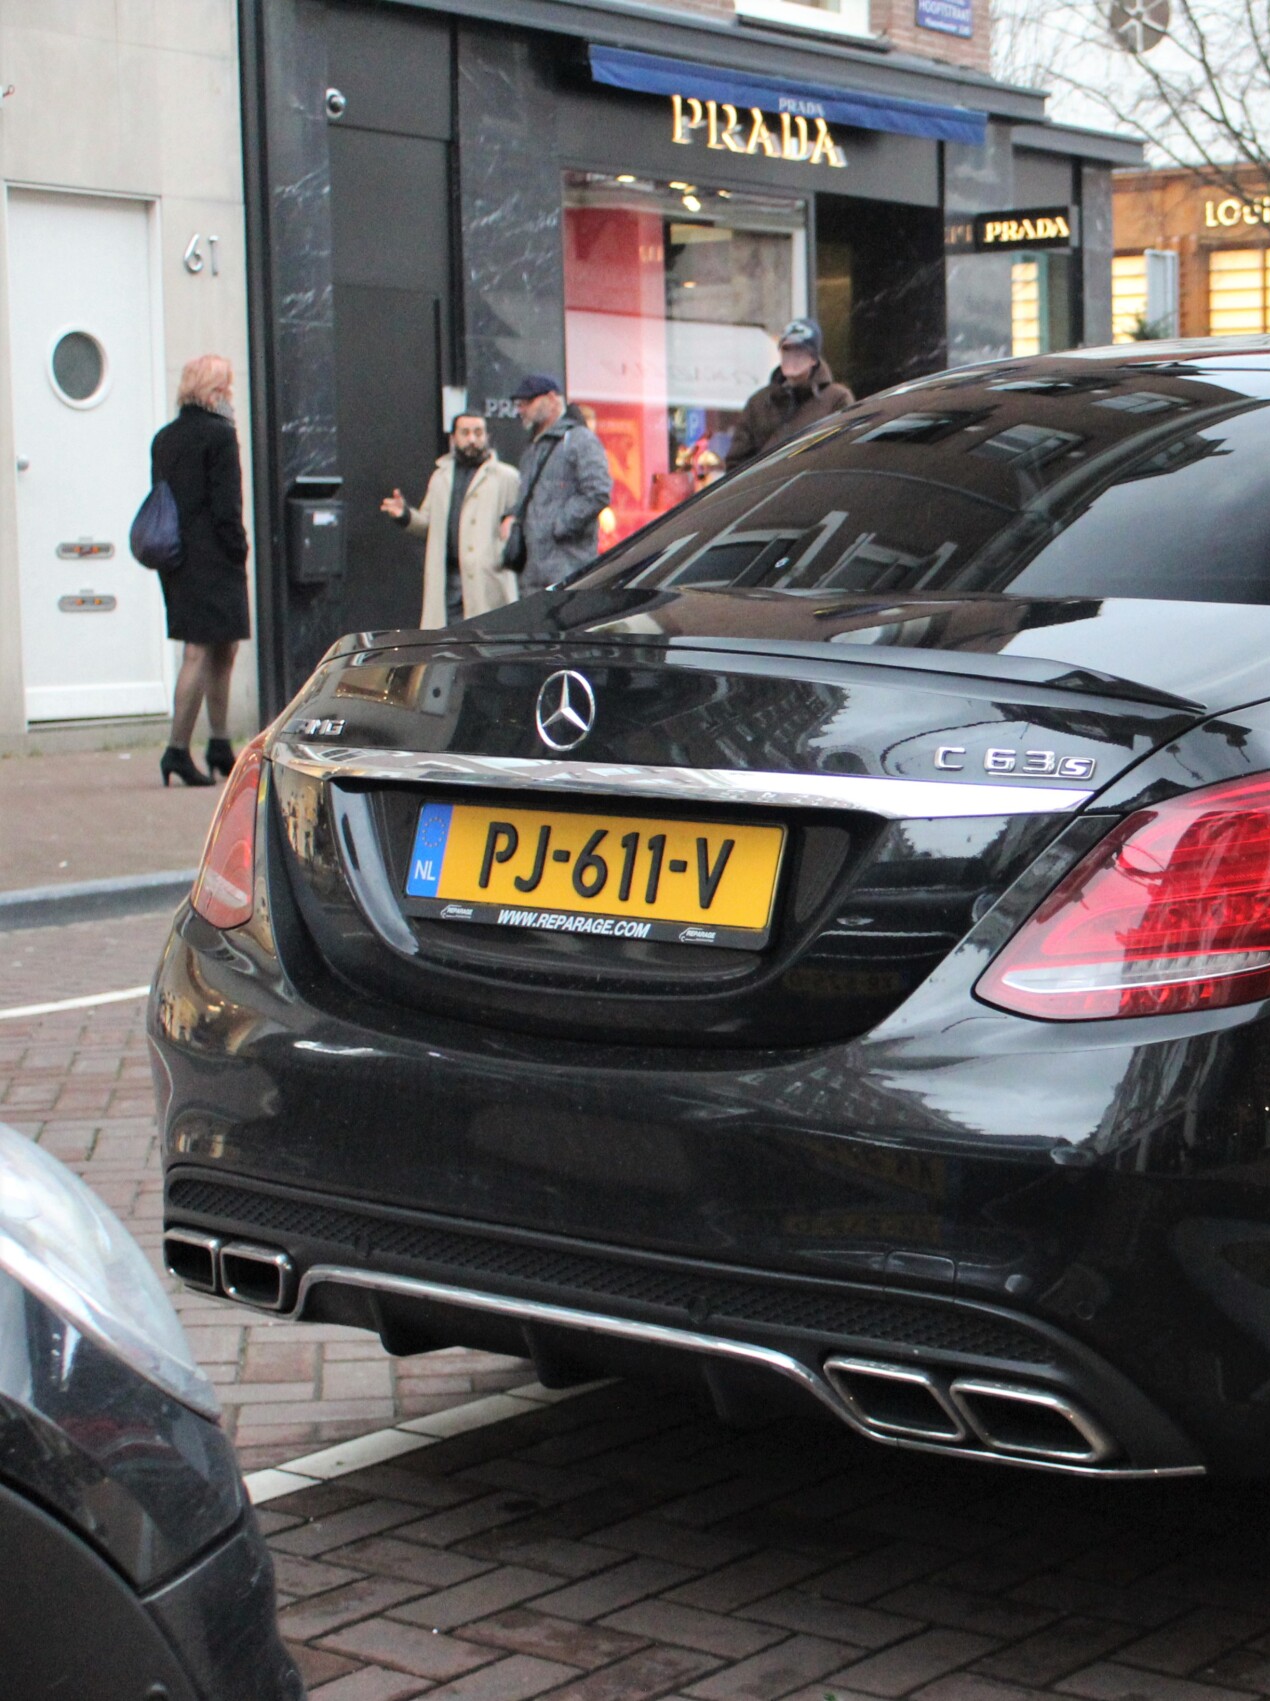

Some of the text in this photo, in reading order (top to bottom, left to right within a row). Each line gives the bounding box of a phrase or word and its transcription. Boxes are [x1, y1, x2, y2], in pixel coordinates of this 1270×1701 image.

[778, 97, 826, 118] PRADA
[672, 94, 848, 168] PRADA
[984, 216, 1070, 243] PRADA
[183, 233, 220, 277] 61
[934, 746, 966, 771] C
[414, 860, 436, 881] NL
[478, 821, 736, 910] PJ-611-V
[497, 909, 651, 938] WWW.REPARAGE.COM
